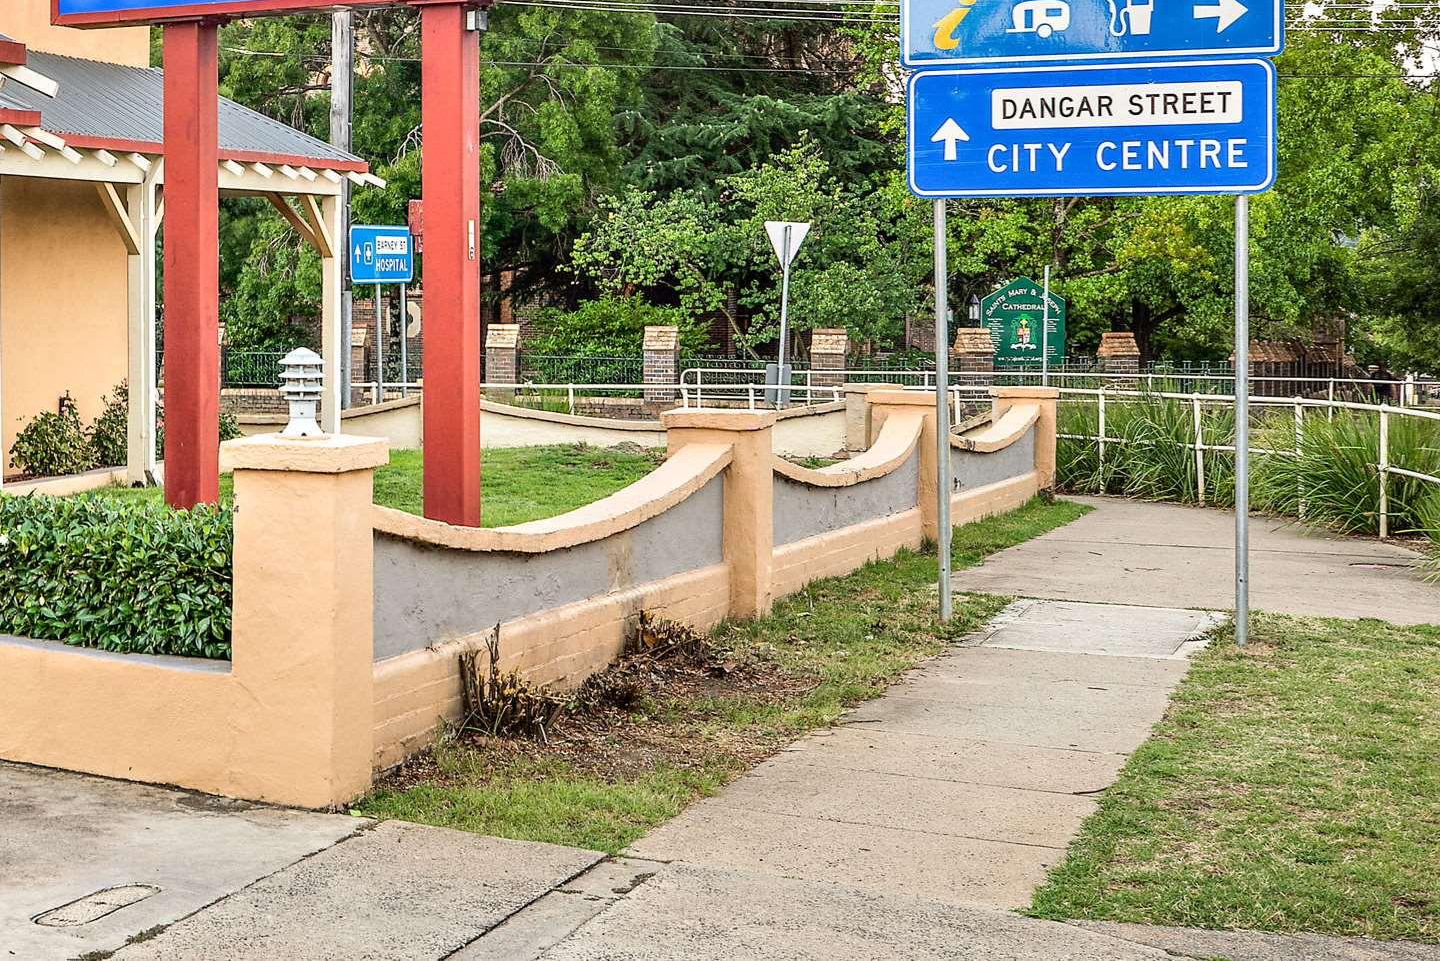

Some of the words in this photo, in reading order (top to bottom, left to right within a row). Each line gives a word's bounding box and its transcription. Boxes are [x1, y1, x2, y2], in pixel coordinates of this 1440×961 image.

[1002, 96, 1113, 120] DANGAR
[1128, 91, 1233, 117] STREET
[987, 142, 1072, 173] CITY
[1096, 138, 1249, 171] CENTRE
[376, 258, 408, 272] HOSPITAL
[986, 295, 1006, 316] SAINTS
[1008, 288, 1028, 297] MARY
[1030, 288, 1037, 296] &
[1002, 303, 1046, 311] CATHEDRAL
